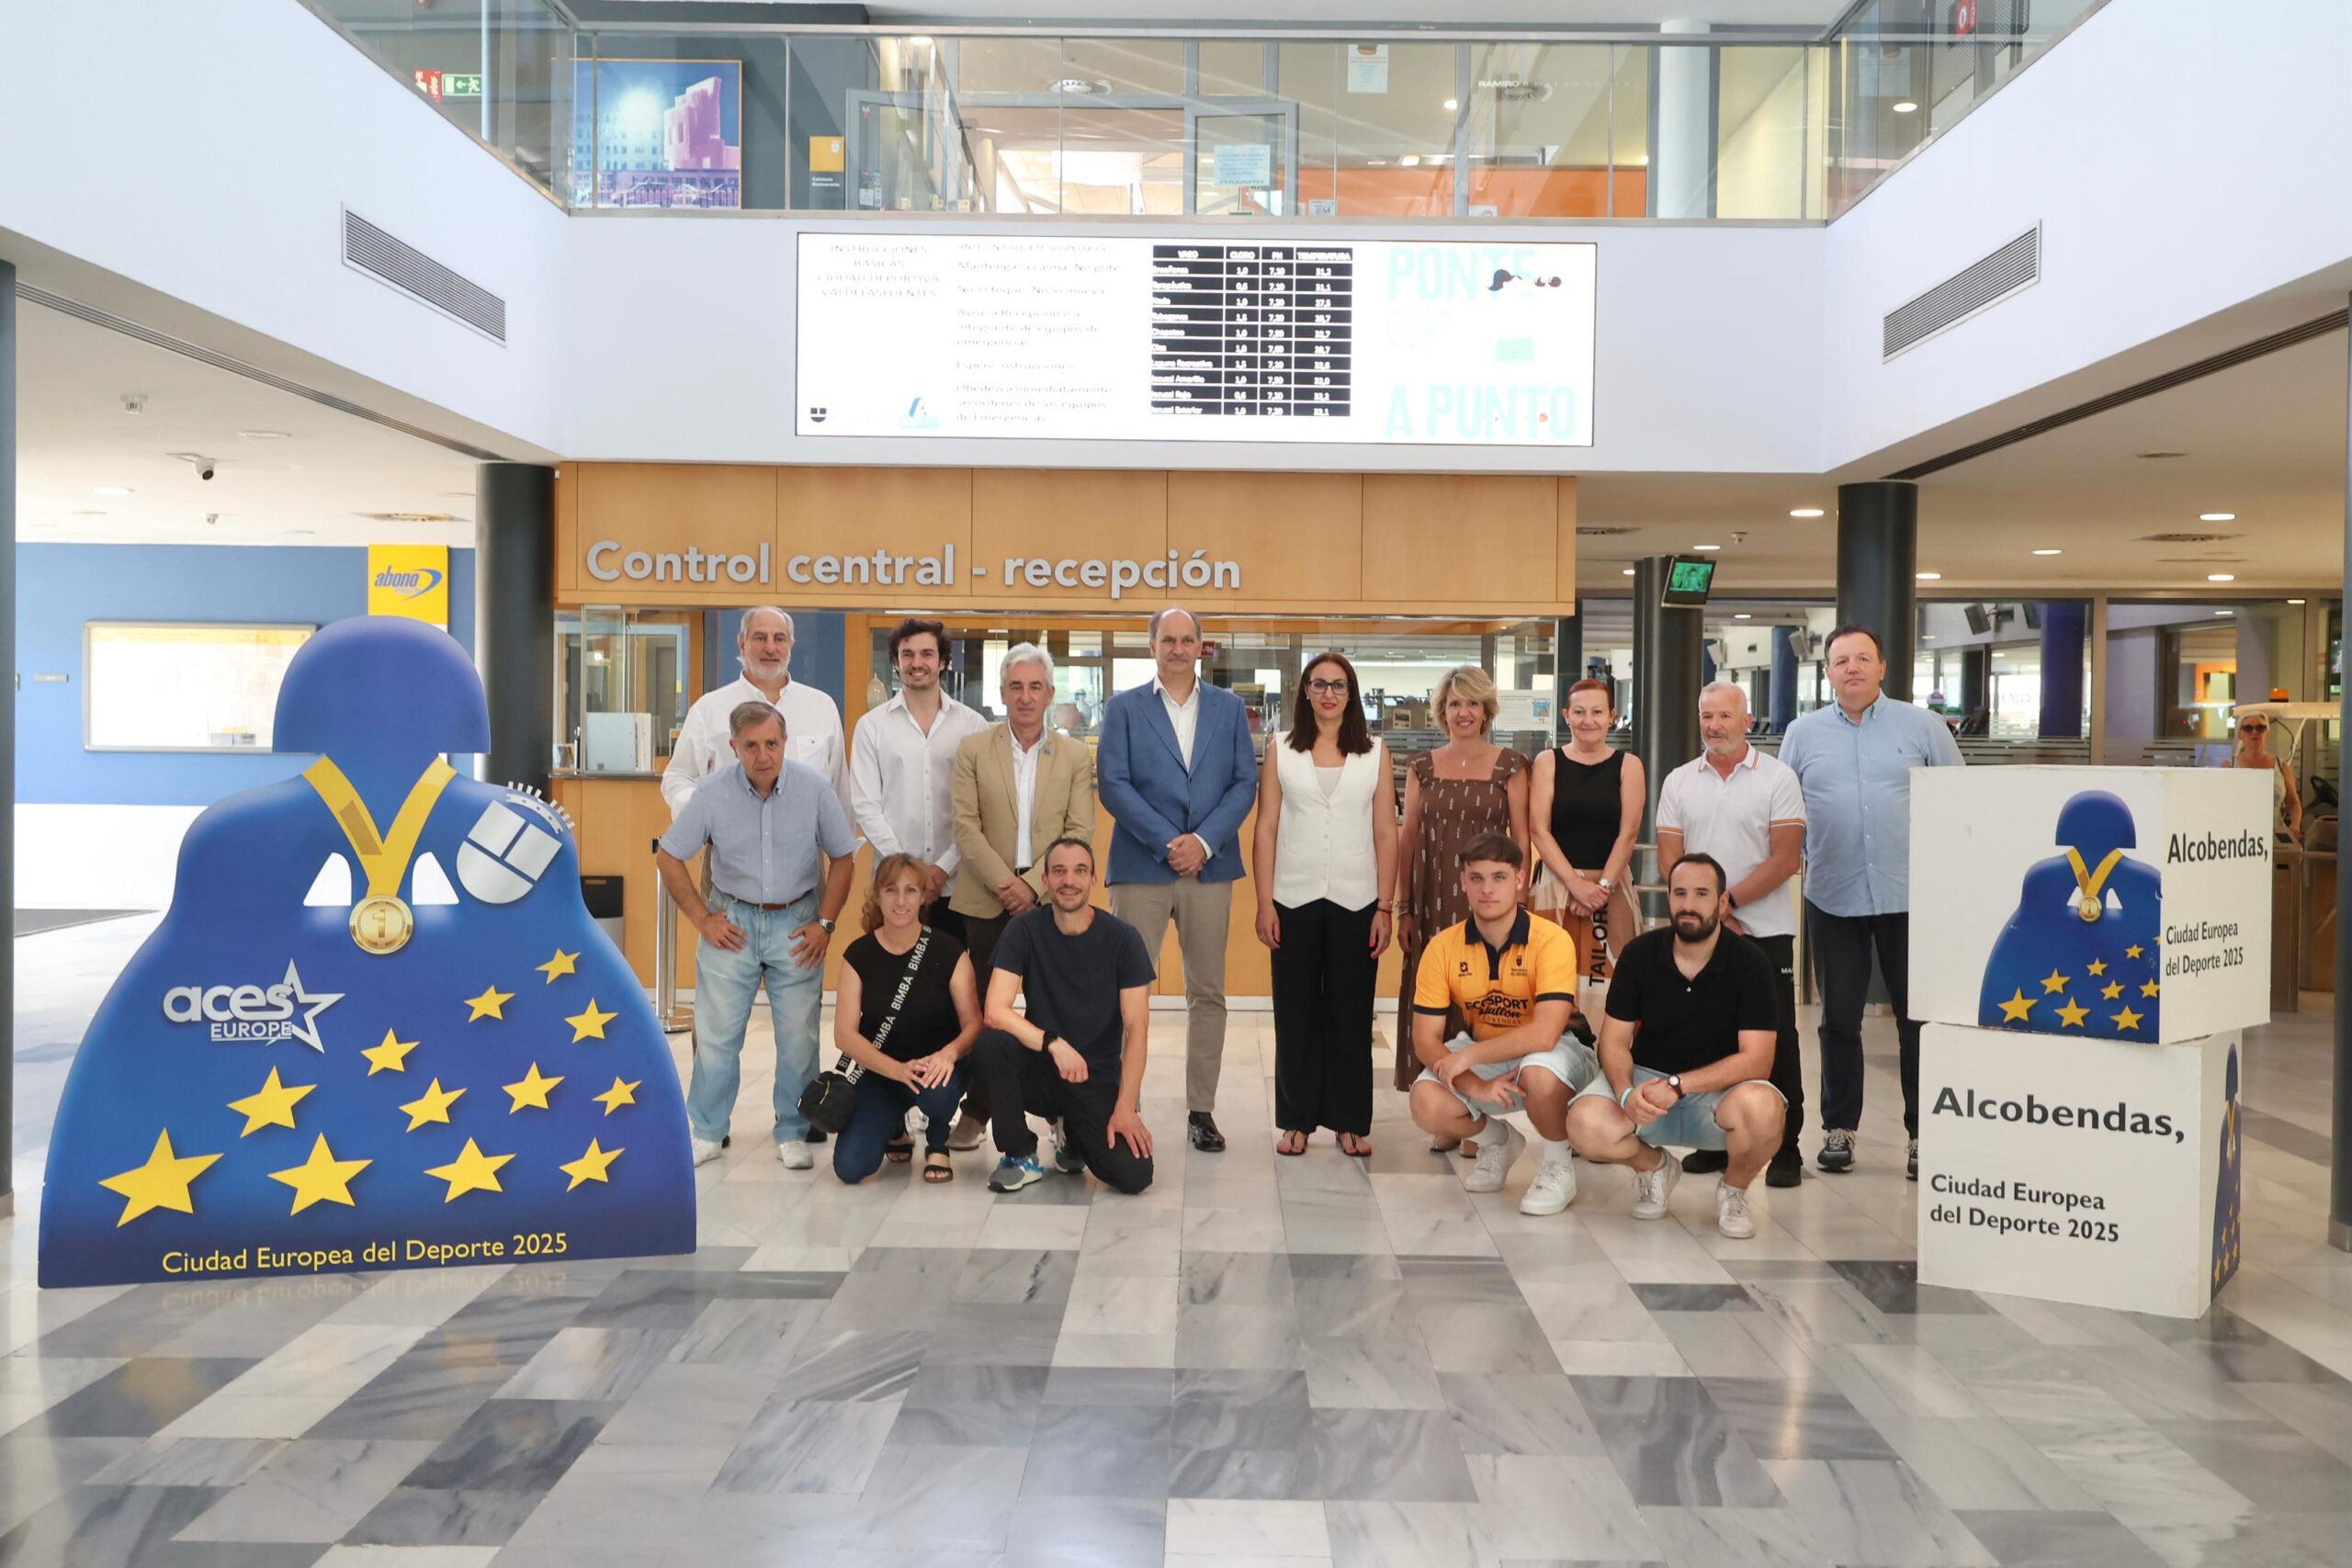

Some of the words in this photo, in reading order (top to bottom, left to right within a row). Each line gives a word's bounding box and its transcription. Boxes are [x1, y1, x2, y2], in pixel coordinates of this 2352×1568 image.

[1477, 80, 1520, 88] RAMIRO
[1383, 383, 1413, 438] A
[1426, 384, 1576, 440] PUNTO
[374, 565, 419, 587] abono
[586, 540, 770, 583] Control
[787, 543, 955, 585] central
[972, 567, 987, 576] -
[1005, 548, 1240, 600] recepción
[2167, 829, 2268, 864] Alcobendas,
[2165, 922, 2199, 945] Ciudad
[2201, 921, 2238, 943] Europea
[908, 936, 930, 971] BIMBA
[2165, 955, 2180, 976] del
[2182, 953, 2221, 977] Deporte
[2222, 946, 2244, 967] 2025
[163, 984, 294, 1022] aces
[891, 976, 914, 1011] BIMBA
[210, 1021, 293, 1039] EUROPE
[873, 1015, 896, 1050] BIMBA
[1932, 1087, 2185, 1144] Alcobendas,
[1930, 1174, 2006, 1200] Ciudad
[2013, 1182, 2106, 1213] Europea
[1930, 1204, 1961, 1224] del
[1969, 1207, 2060, 1235] Deporte
[2068, 1218, 2120, 1243] 2025
[162, 1248, 248, 1274] Ciudad
[256, 1247, 354, 1271] Europea
[363, 1241, 396, 1263] del
[406, 1238, 504, 1266] Deporte
[513, 1233, 568, 1256] 2025
